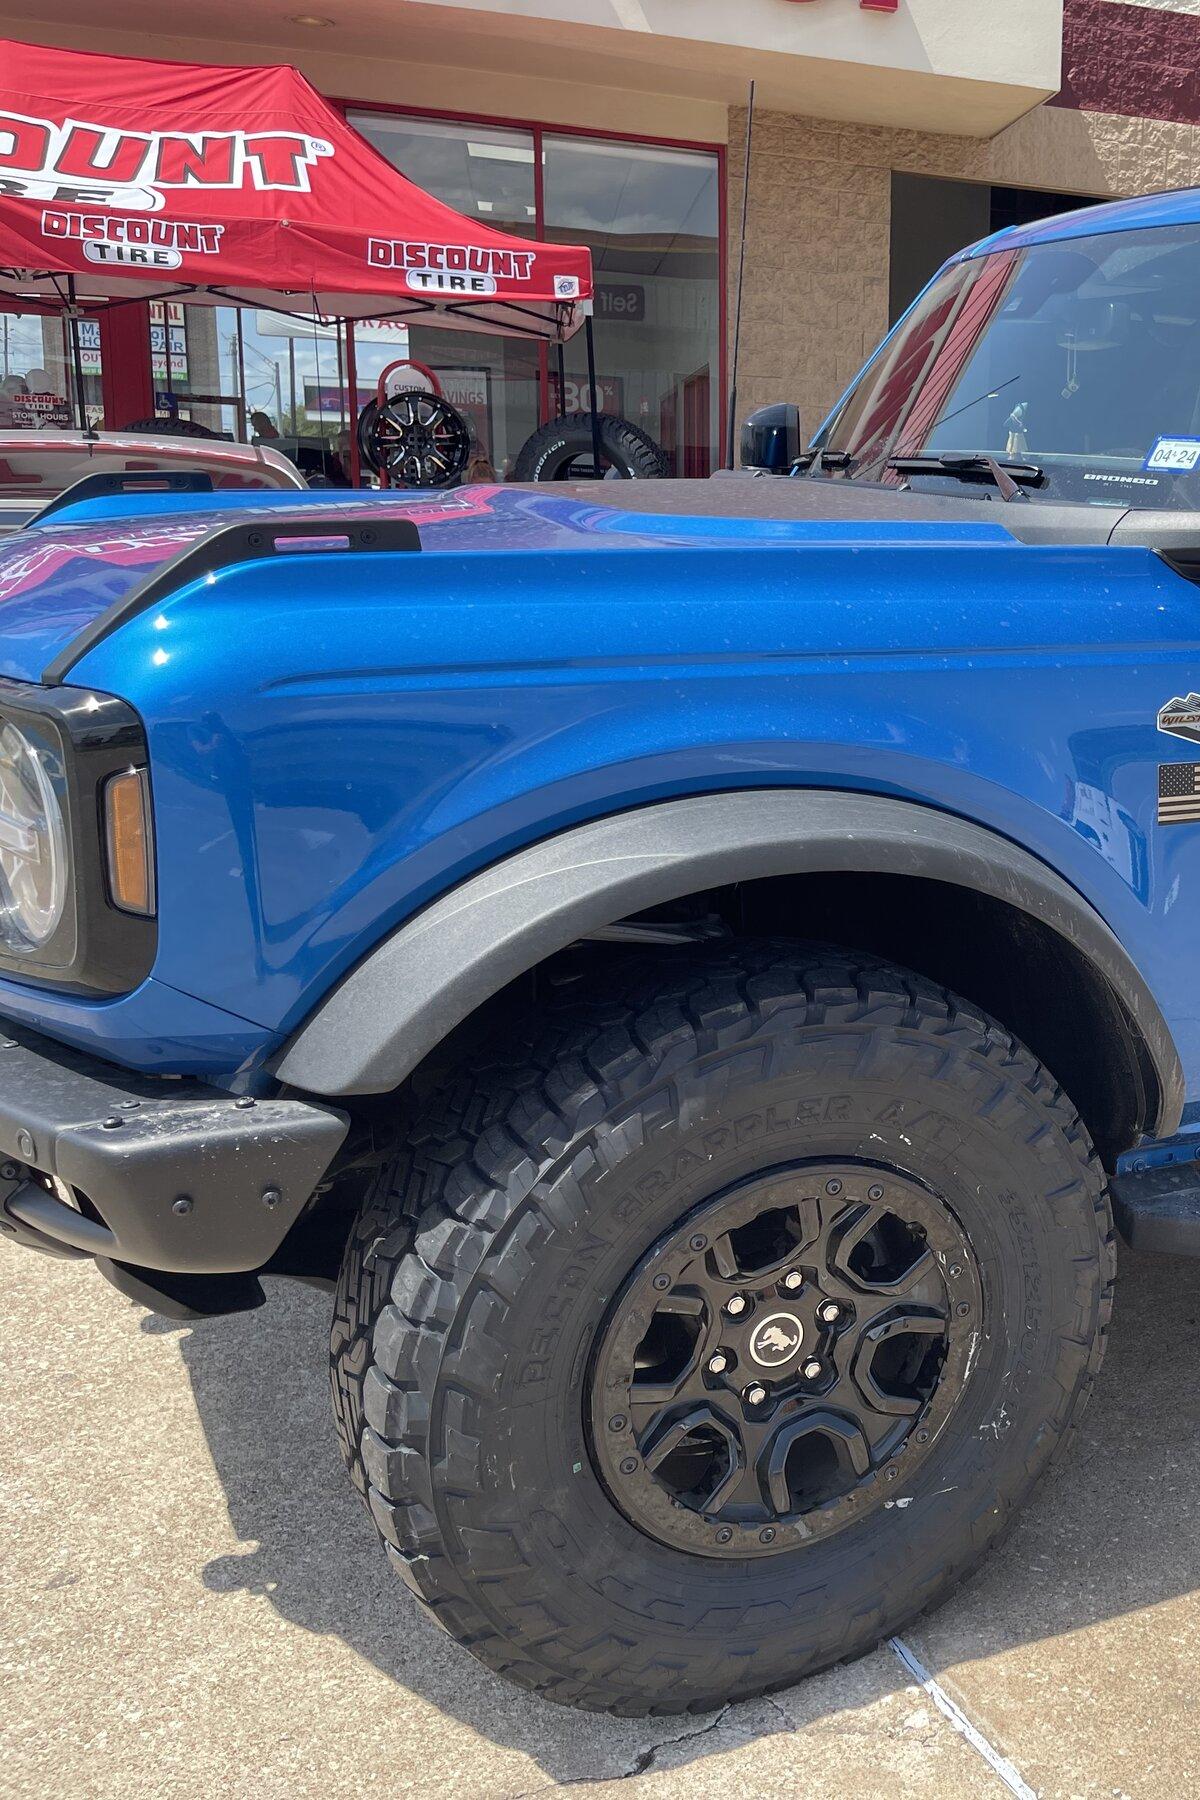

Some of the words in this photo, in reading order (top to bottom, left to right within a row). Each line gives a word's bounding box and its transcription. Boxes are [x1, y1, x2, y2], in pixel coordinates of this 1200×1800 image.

[43, 212, 221, 252] DISCOUNT
[92, 243, 170, 265] TIRE
[370, 241, 531, 278] DISCOUNT
[416, 272, 485, 291] TIRE
[14, 395, 65, 405] DISCOUNT
[1083, 473, 1159, 486] BRONCO
